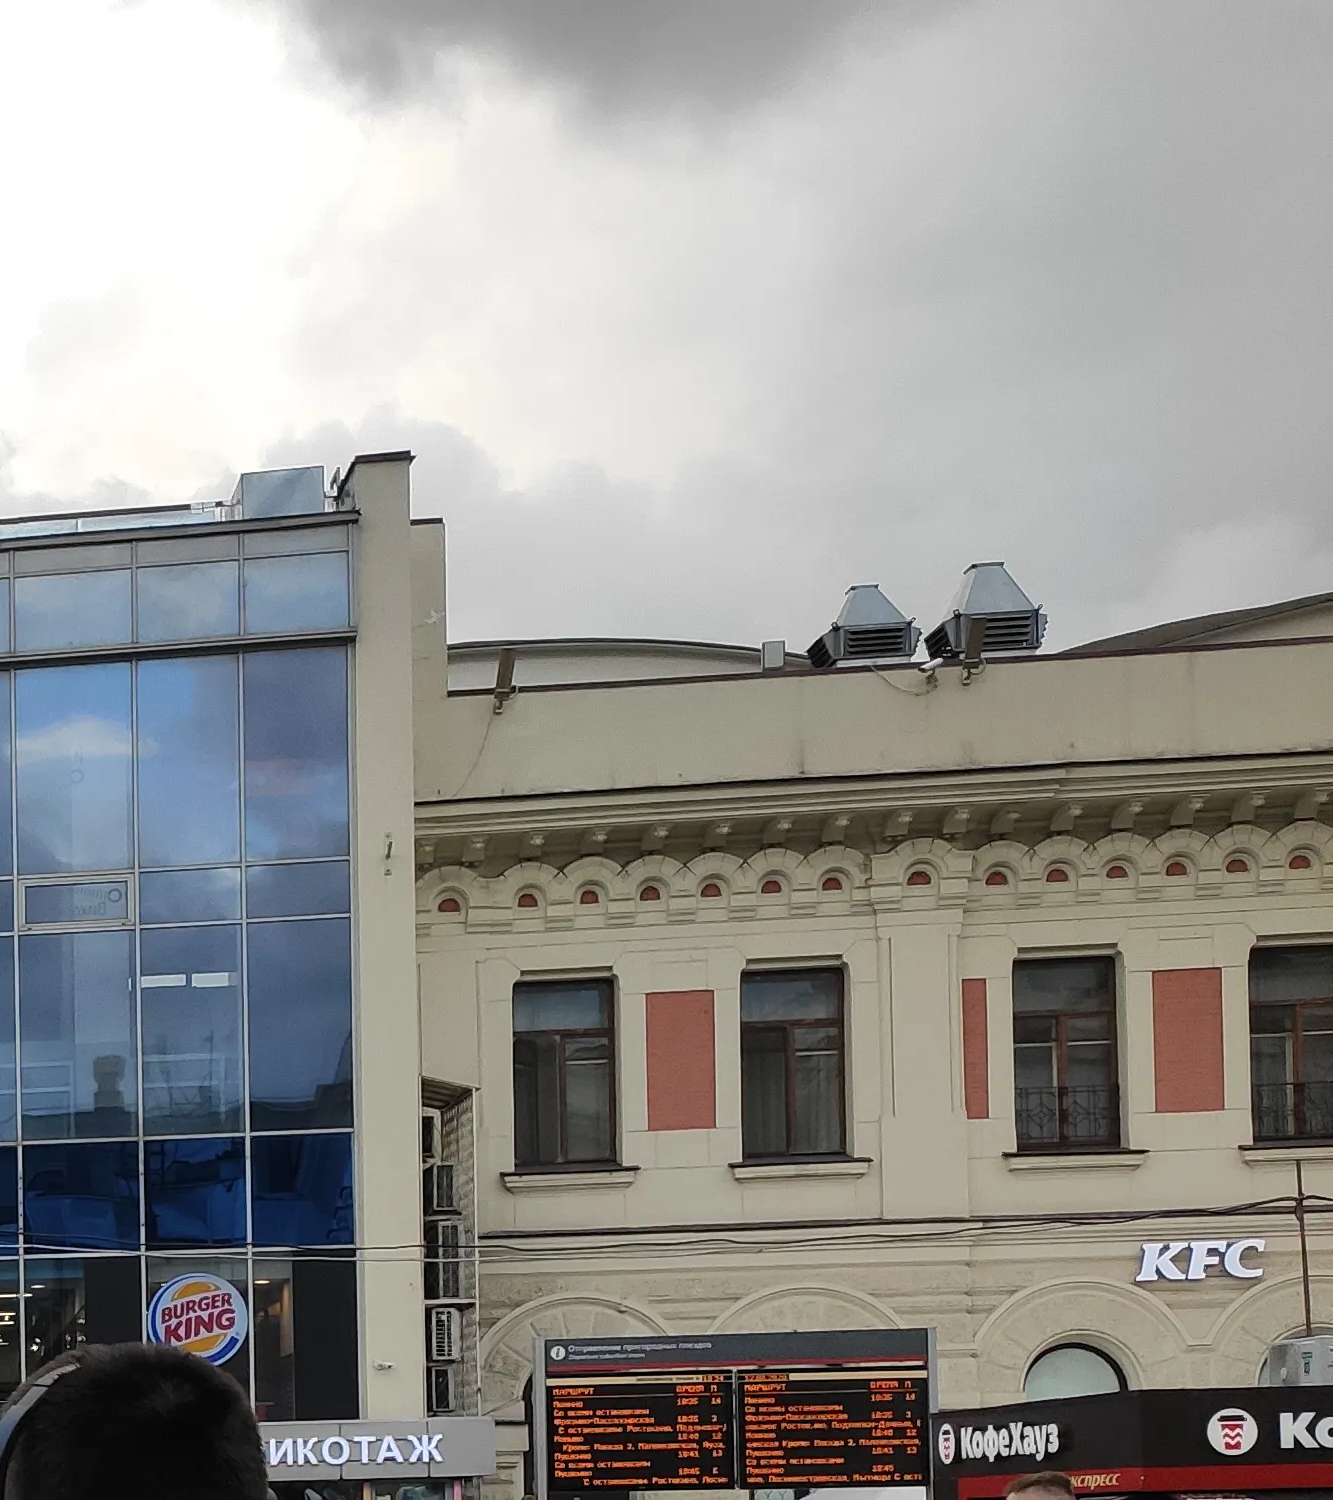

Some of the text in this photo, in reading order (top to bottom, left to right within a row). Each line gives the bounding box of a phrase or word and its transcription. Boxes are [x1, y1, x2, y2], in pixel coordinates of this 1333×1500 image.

[1136, 1239, 1265, 1281] KFC
[161, 1293, 233, 1324] BURGER
[164, 1308, 235, 1344] KING
[961, 1422, 1059, 1462] КофеХауз
